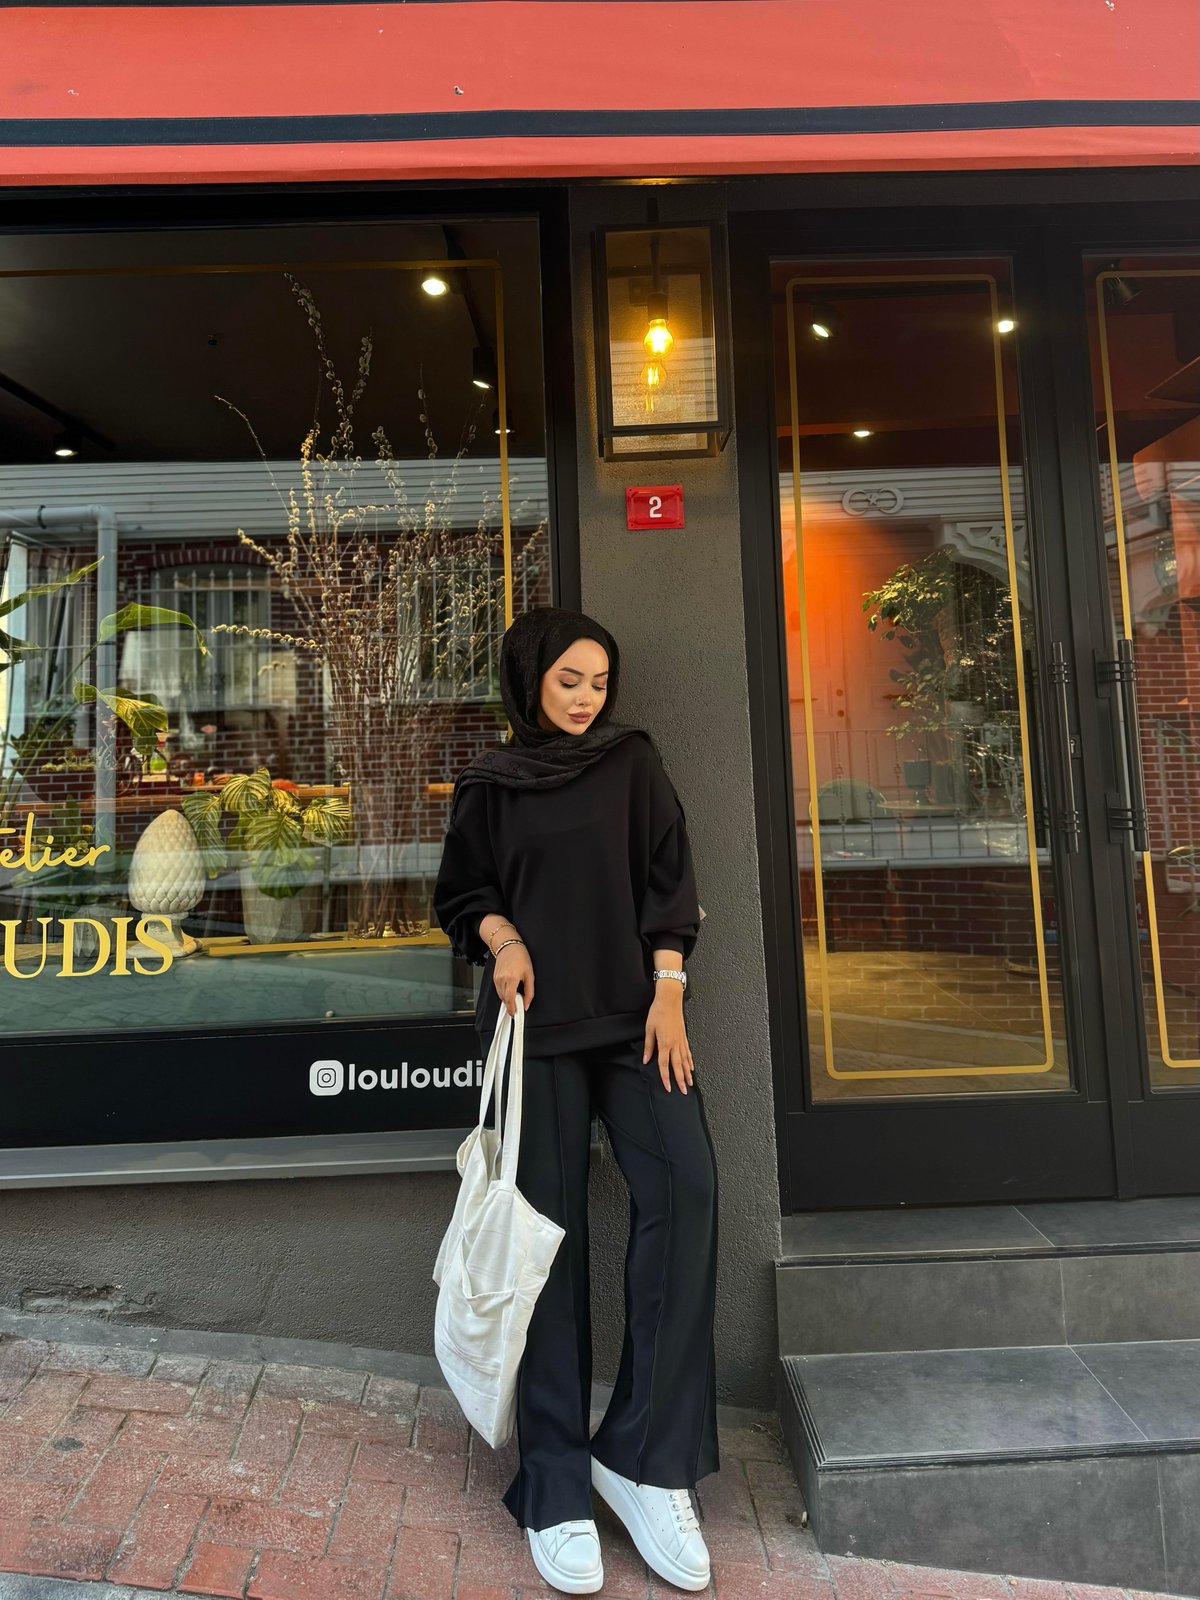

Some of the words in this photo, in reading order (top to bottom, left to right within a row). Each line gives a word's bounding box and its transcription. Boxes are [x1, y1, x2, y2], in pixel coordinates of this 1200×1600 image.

[649, 496, 662, 518] 2
[0, 916, 174, 979] UDIS
[348, 1060, 483, 1090] louloudi
